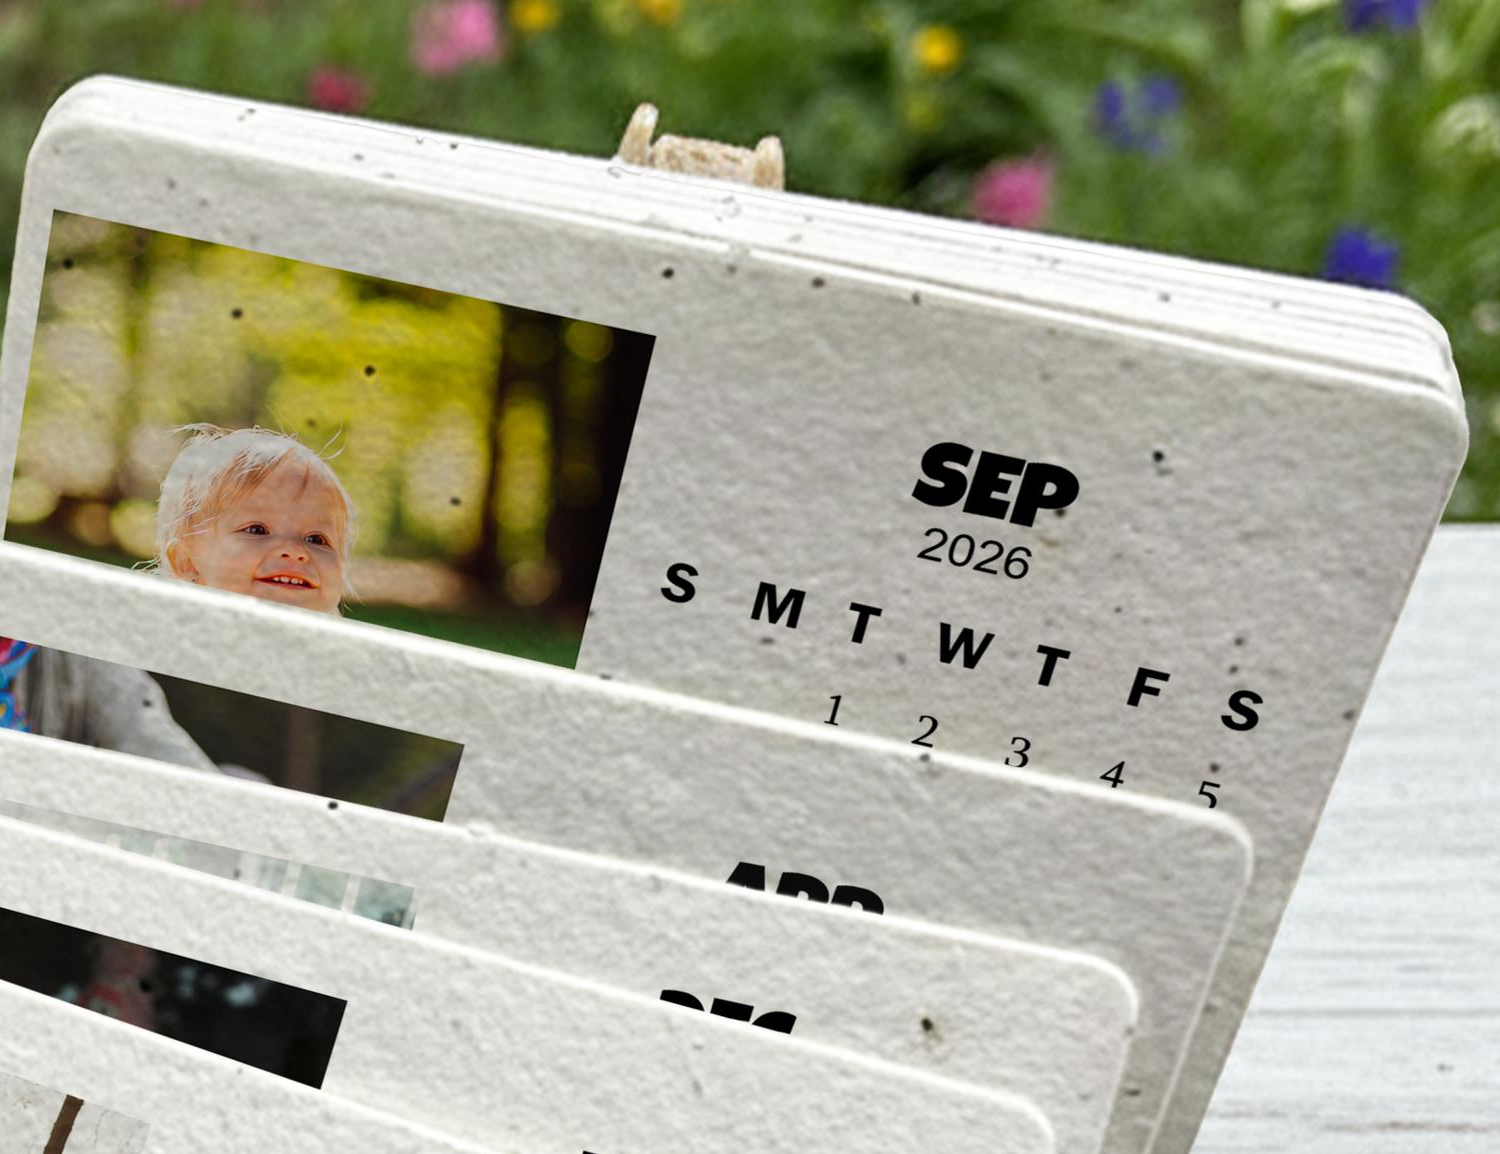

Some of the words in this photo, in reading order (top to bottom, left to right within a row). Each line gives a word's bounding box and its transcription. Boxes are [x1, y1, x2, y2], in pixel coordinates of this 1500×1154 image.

[911, 441, 1080, 528] SEP
[916, 527, 1033, 580] 2026
[660, 562, 699, 604] S
[750, 581, 807, 629] M
[849, 601, 883, 645] T
[939, 621, 996, 670] W
[1036, 644, 1072, 687] T
[1126, 666, 1171, 708] F
[1220, 689, 1264, 732] S
[823, 694, 842, 727] 1
[911, 715, 939, 748] 2
[1004, 736, 1033, 768] 3
[1099, 760, 1125, 789] 4
[1198, 780, 1221, 809] 5
